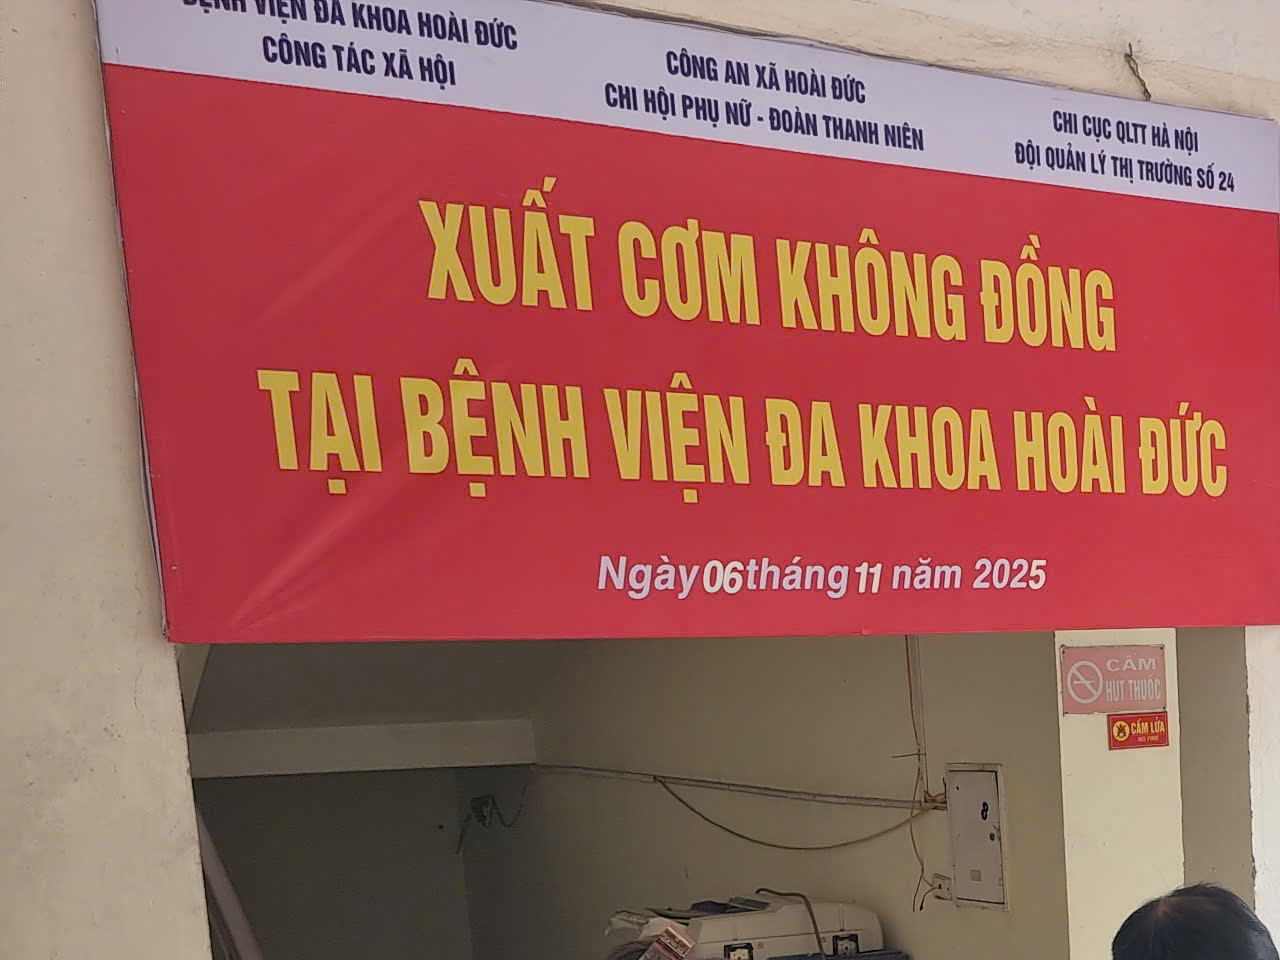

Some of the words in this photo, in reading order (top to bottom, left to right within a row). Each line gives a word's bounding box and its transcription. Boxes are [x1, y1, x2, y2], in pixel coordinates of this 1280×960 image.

[314, 0, 345, 25] ĐA
[352, 2, 412, 35] KHOA
[418, 11, 469, 43] HOÀI
[475, 18, 518, 50] ĐỨC
[262, 33, 326, 68] CÔNG
[332, 42, 375, 75] TÁC
[382, 49, 413, 80] XÃ
[419, 53, 456, 90] HỘI
[665, 47, 718, 82] CÔNG
[724, 60, 750, 87] AN
[755, 62, 780, 91] XÃ
[785, 68, 826, 98] HOÀI
[831, 74, 866, 104] ĐỨC
[605, 83, 638, 110] CHI
[644, 86, 676, 120] HỘI
[681, 95, 719, 128] PHỤ
[725, 99, 752, 128] NỮ
[768, 105, 818, 137] ĐOÀN
[822, 113, 879, 146] THANH
[884, 121, 924, 151] NIÊN
[1052, 110, 1079, 135] CHI
[1083, 115, 1112, 142] CỤC
[1115, 121, 1147, 147] QLTT
[1151, 122, 1171, 149] HÀ
[1174, 127, 1199, 156] NỘI
[1014, 139, 1041, 170] ĐỘI
[1045, 143, 1086, 172] QUẢN
[1090, 148, 1107, 176] LÝ
[1111, 156, 1134, 184] THỊ
[1137, 153, 1192, 188] TRƯỜNG
[1196, 161, 1215, 190] SỐ
[1218, 171, 1236, 192] 24
[418, 177, 594, 311] XUẤT
[618, 218, 760, 325] CƠM
[776, 228, 966, 341] KHÔNG
[980, 234, 1116, 352] ĐỒNG
[257, 370, 383, 494] TẠI
[400, 358, 590, 497] BỆNH
[604, 372, 750, 503] VIỆN
[765, 398, 845, 487] ĐA
[858, 403, 1001, 490] KHOA
[1013, 396, 1126, 494] HOÀI
[1138, 401, 1228, 497] ĐỨC
[598, 555, 699, 600] Ngày
[702, 559, 744, 594] 06
[746, 556, 849, 599] tháng
[854, 562, 882, 594] 11
[893, 557, 962, 590] năm
[973, 558, 1048, 591] 2025
